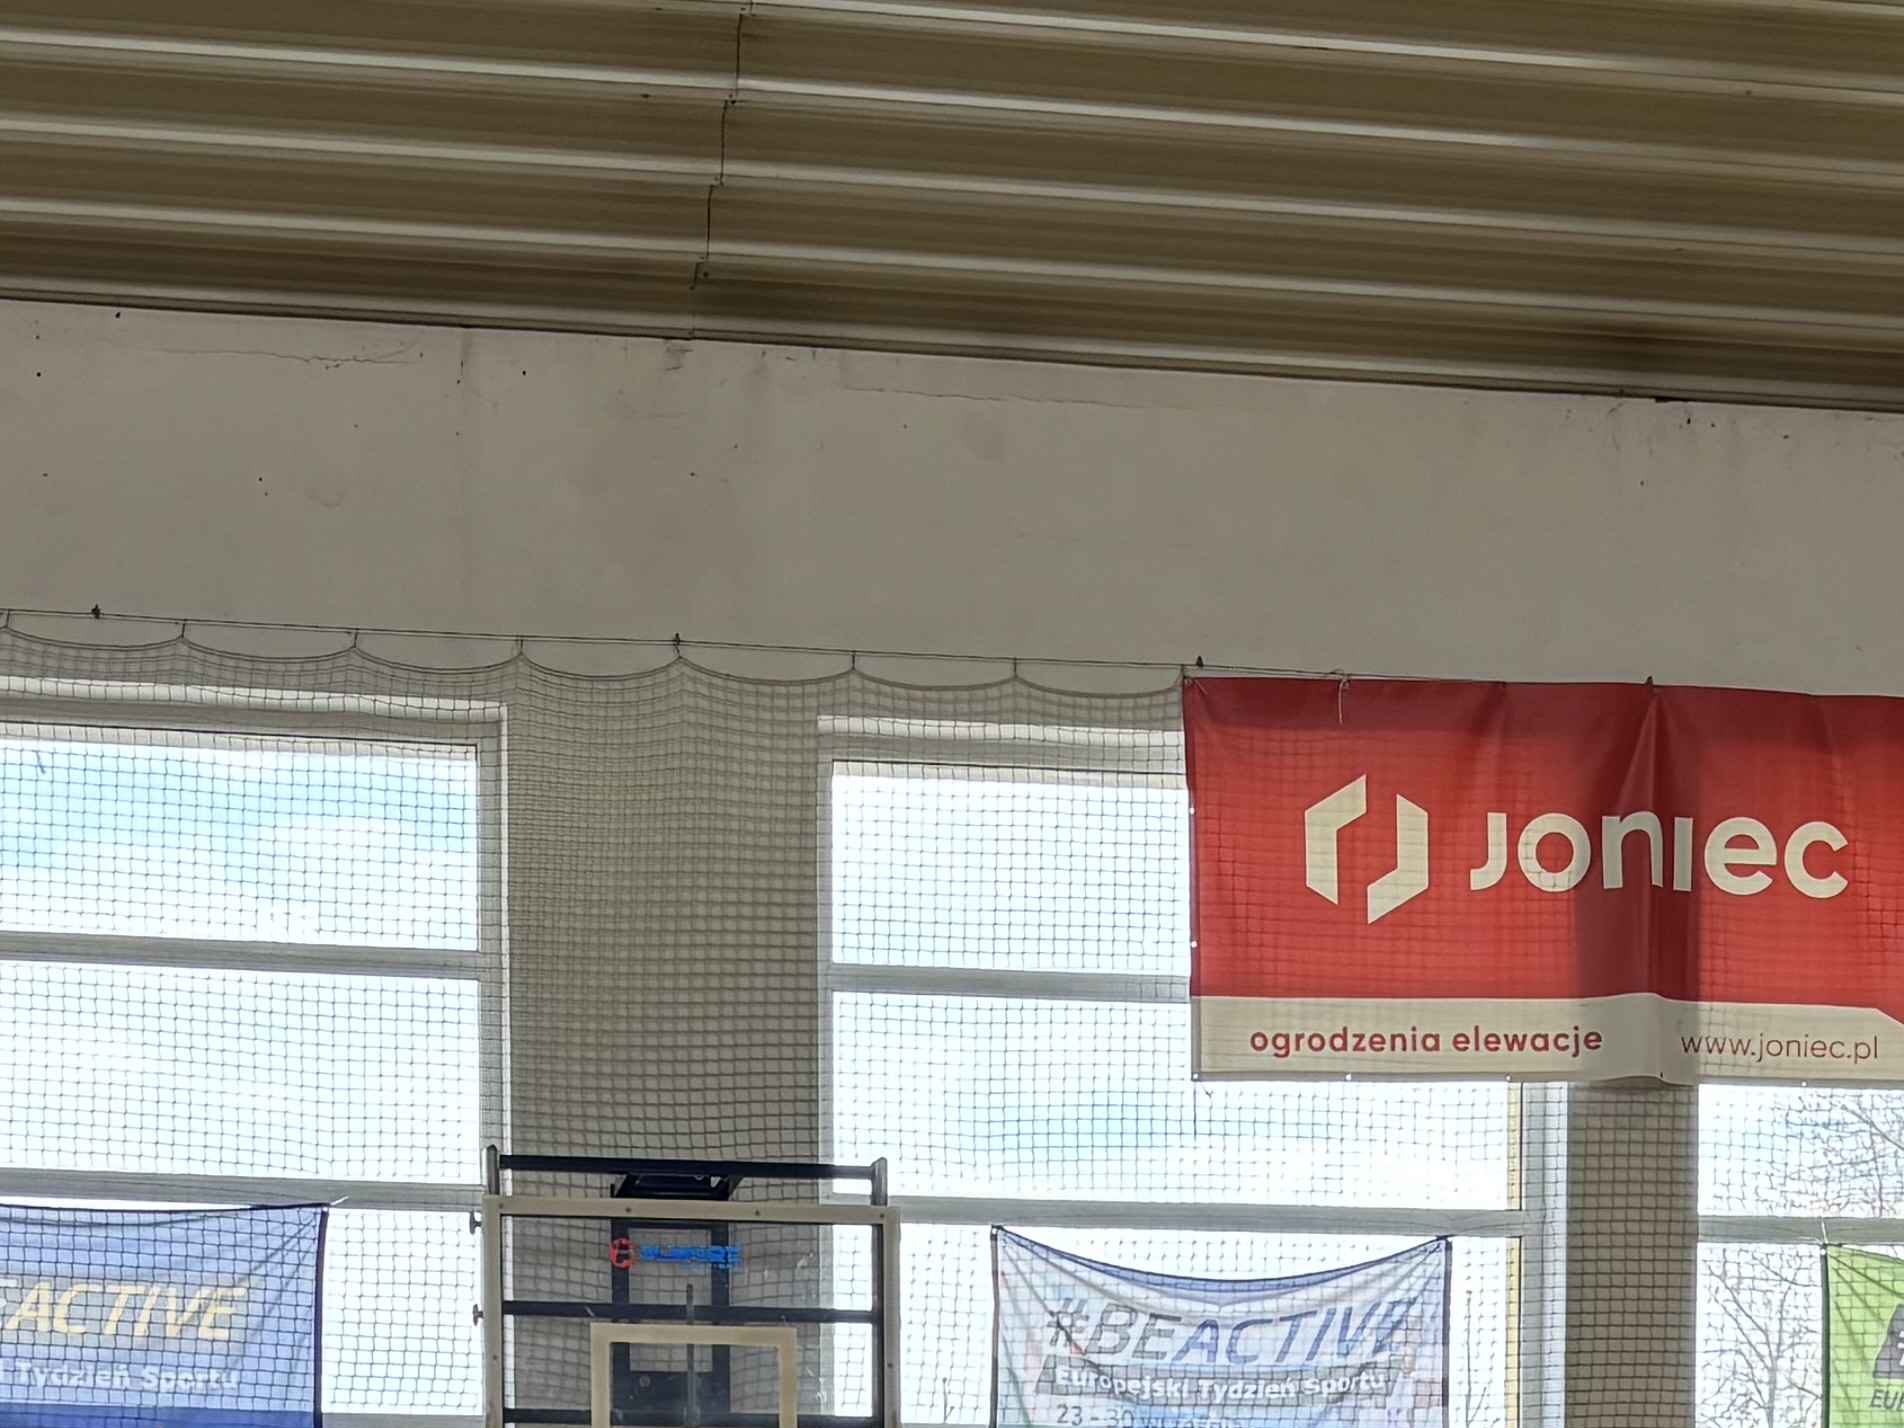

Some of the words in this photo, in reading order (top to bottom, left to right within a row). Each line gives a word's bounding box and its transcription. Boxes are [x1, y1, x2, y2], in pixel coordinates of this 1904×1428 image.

[1249, 1026, 1441, 1060] ogrodzenia
[1452, 1026, 1603, 1058] elewacje
[1681, 1032, 1879, 1065] www.joniec.pl
[141, 1365, 239, 1392] Sportu
[1056, 1366, 1191, 1400] Europejski
[1197, 1376, 1297, 1404] Tydzień
[1299, 1370, 1388, 1397] Sportu
[1056, 1404, 1083, 1427] 23
